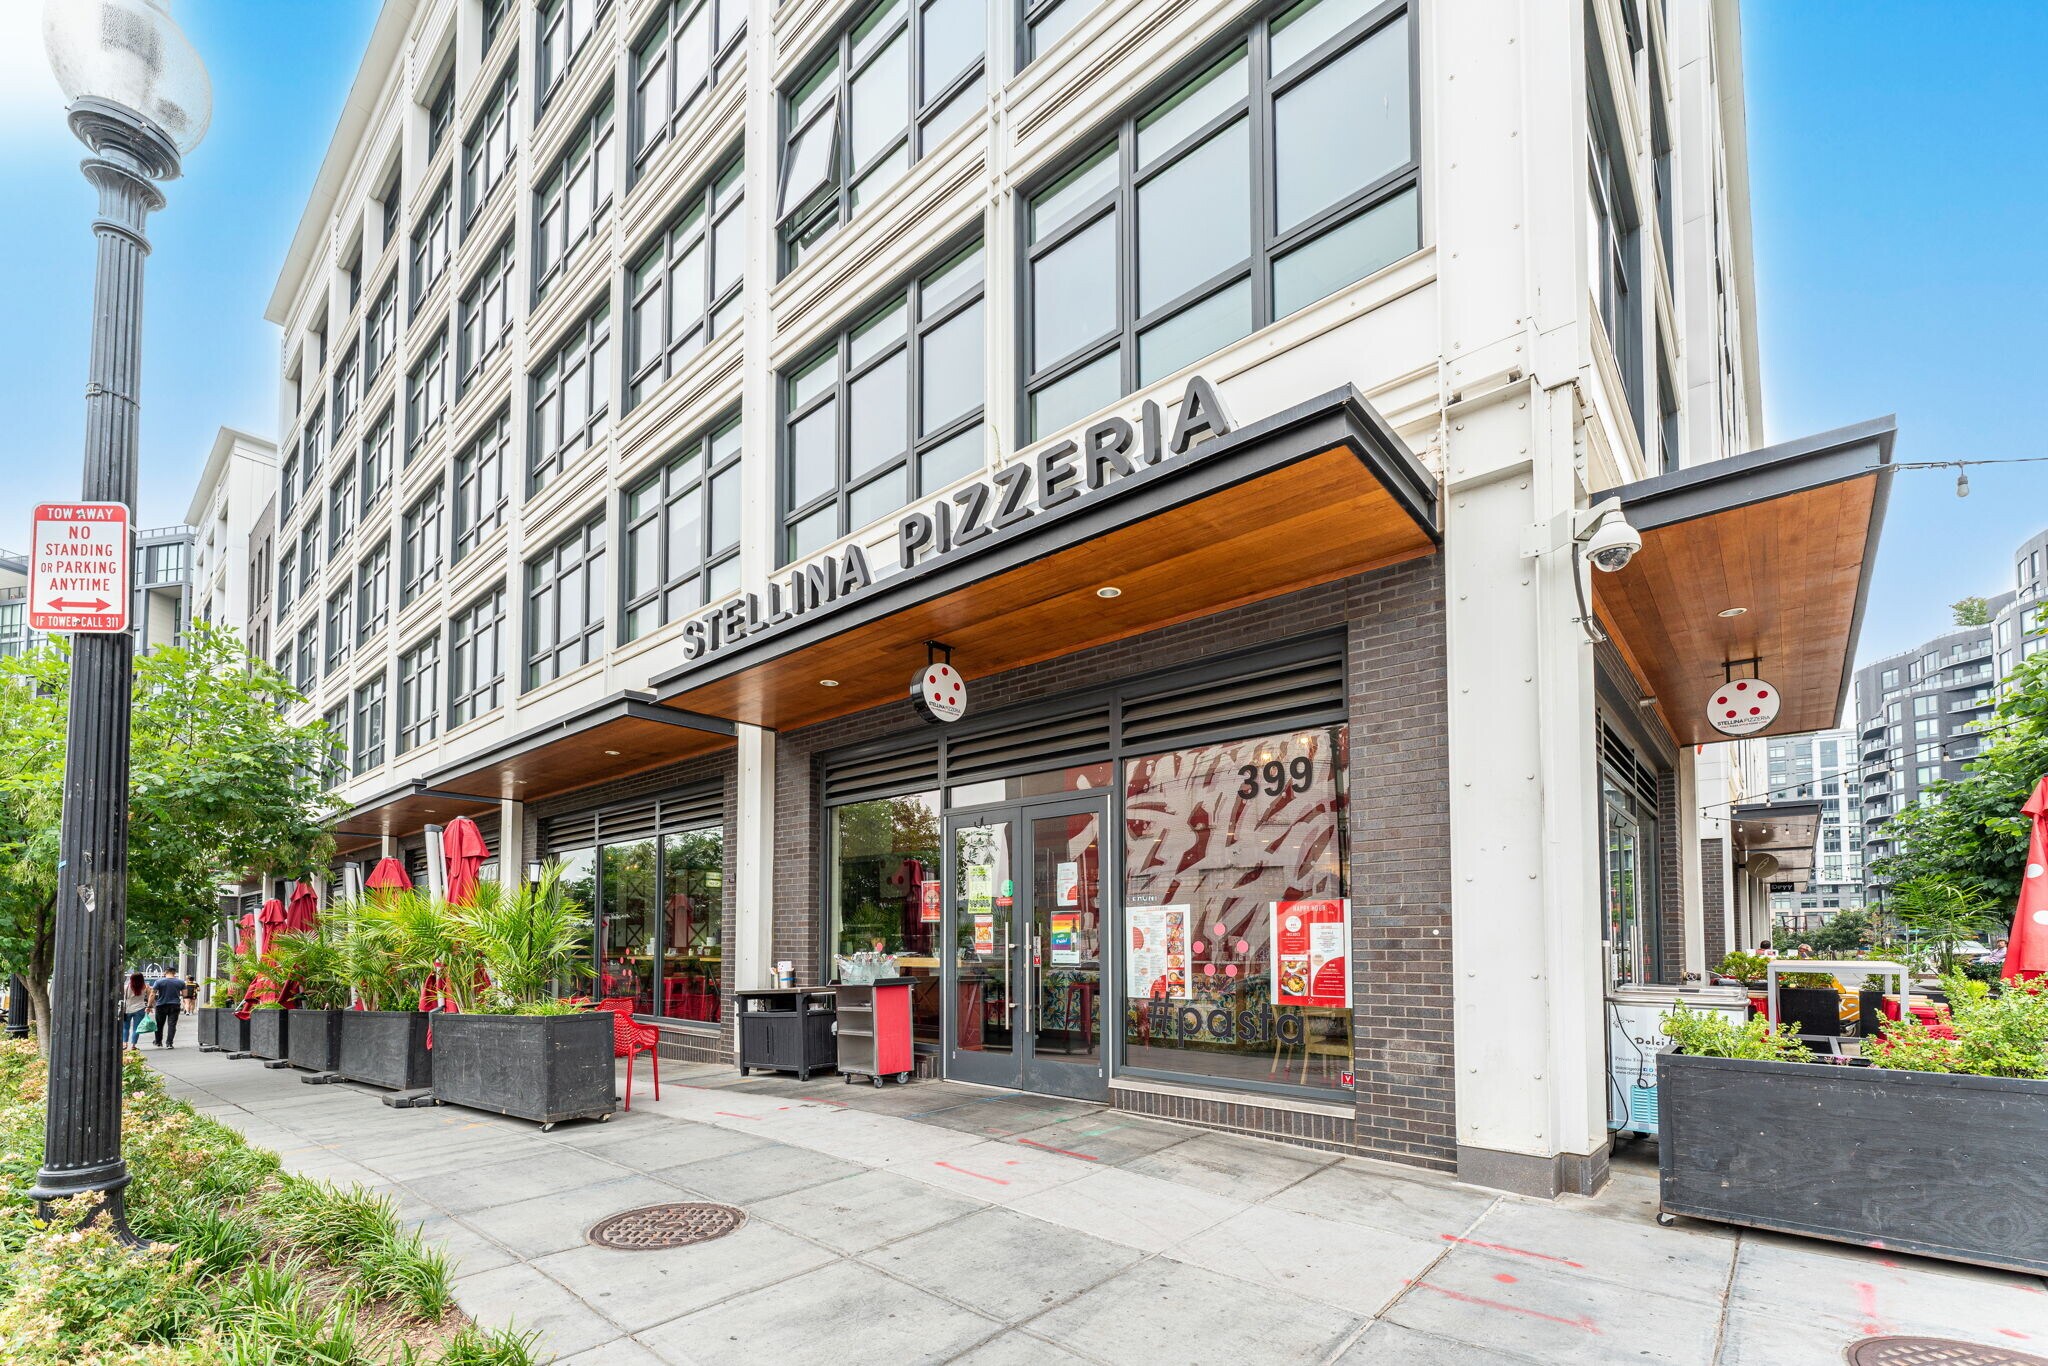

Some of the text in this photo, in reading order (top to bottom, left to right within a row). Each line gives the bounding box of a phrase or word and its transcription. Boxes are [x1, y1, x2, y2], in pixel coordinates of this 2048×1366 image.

[47, 508, 114, 520] TOW AWAY
[683, 376, 1232, 660] STELLINA PIZZERIA
[69, 526, 91, 539] NO
[45, 543, 113, 557] STANDING
[41, 561, 117, 574] OR PARKING
[50, 578, 110, 591] ANYTIME
[36, 616, 119, 628] IF TOWED CALL 311
[1717, 719, 1744, 727] STELLINA
[1744, 715, 1771, 723] PIZZERIA
[1237, 756, 1313, 800] 399
[1147, 991, 1305, 1048] #pasta
[1634, 1035, 1665, 1046] Dolci
